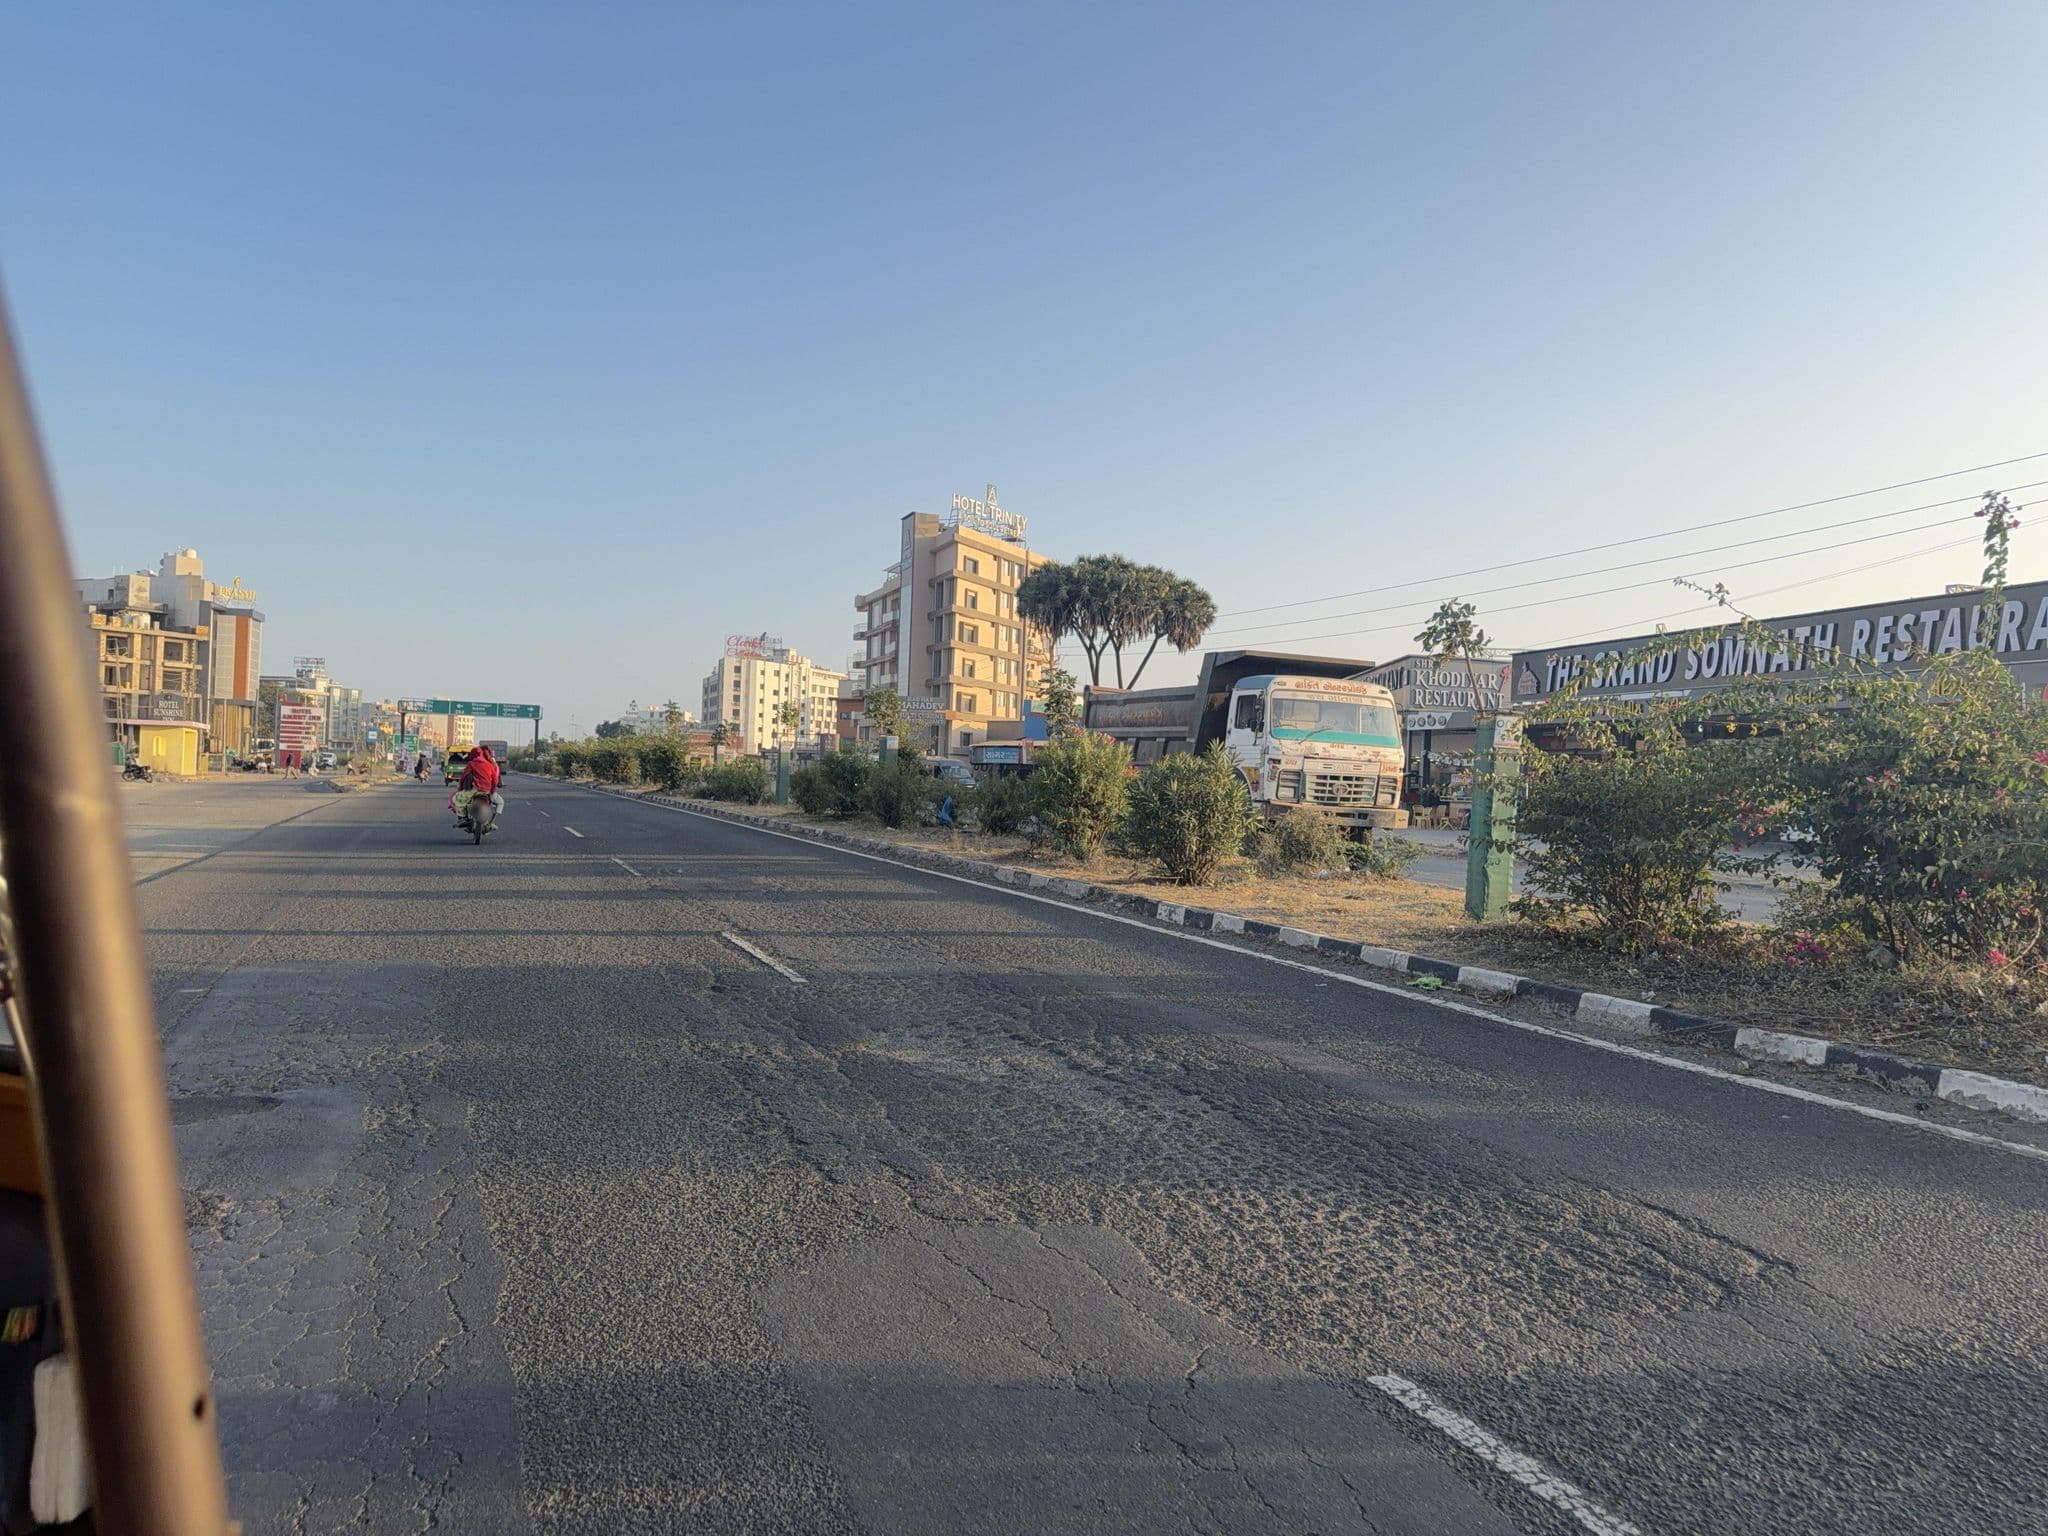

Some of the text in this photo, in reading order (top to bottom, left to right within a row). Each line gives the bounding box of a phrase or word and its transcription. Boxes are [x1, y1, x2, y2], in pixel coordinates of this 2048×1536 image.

[953, 492, 988, 517] HOTEL
[989, 505, 1028, 532] TRINITY
[1545, 653, 1583, 693] THE
[1591, 648, 1676, 689] GRAND
[1685, 623, 1836, 680] SOMNATH
[1415, 669, 1499, 691] KHODIYAR
[159, 700, 179, 709] HOTEL
[1415, 688, 1505, 710] RESTAURANT
[153, 708, 184, 718] SUNSHINE
